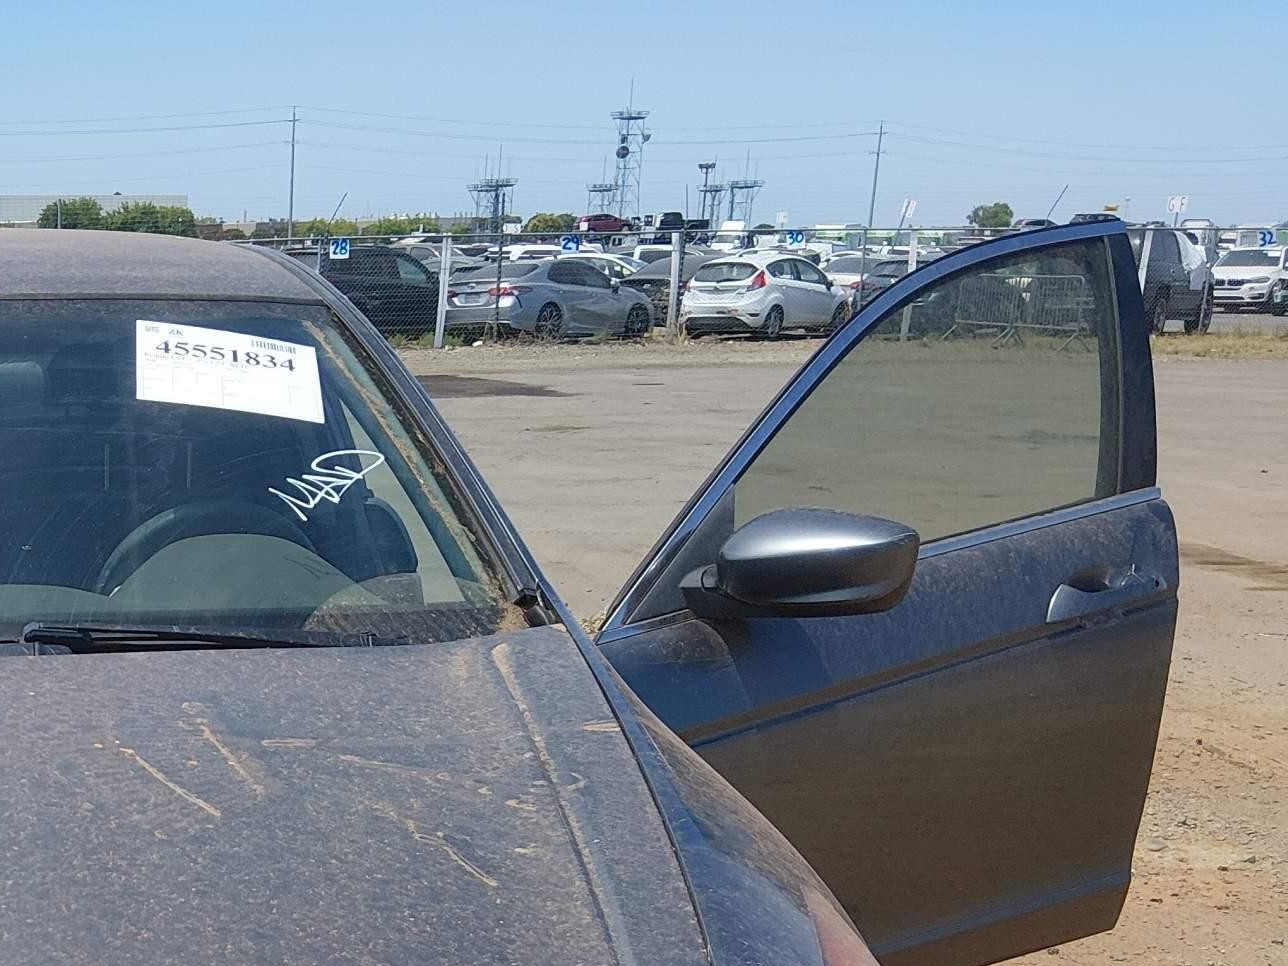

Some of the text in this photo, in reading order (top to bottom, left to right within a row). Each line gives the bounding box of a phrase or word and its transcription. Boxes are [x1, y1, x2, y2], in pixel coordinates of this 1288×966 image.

[561, 235, 580, 251] 29
[788, 231, 804, 246] 30
[1258, 231, 1277, 247] 32
[331, 239, 348, 256] 28
[155, 339, 296, 372] 45551834
